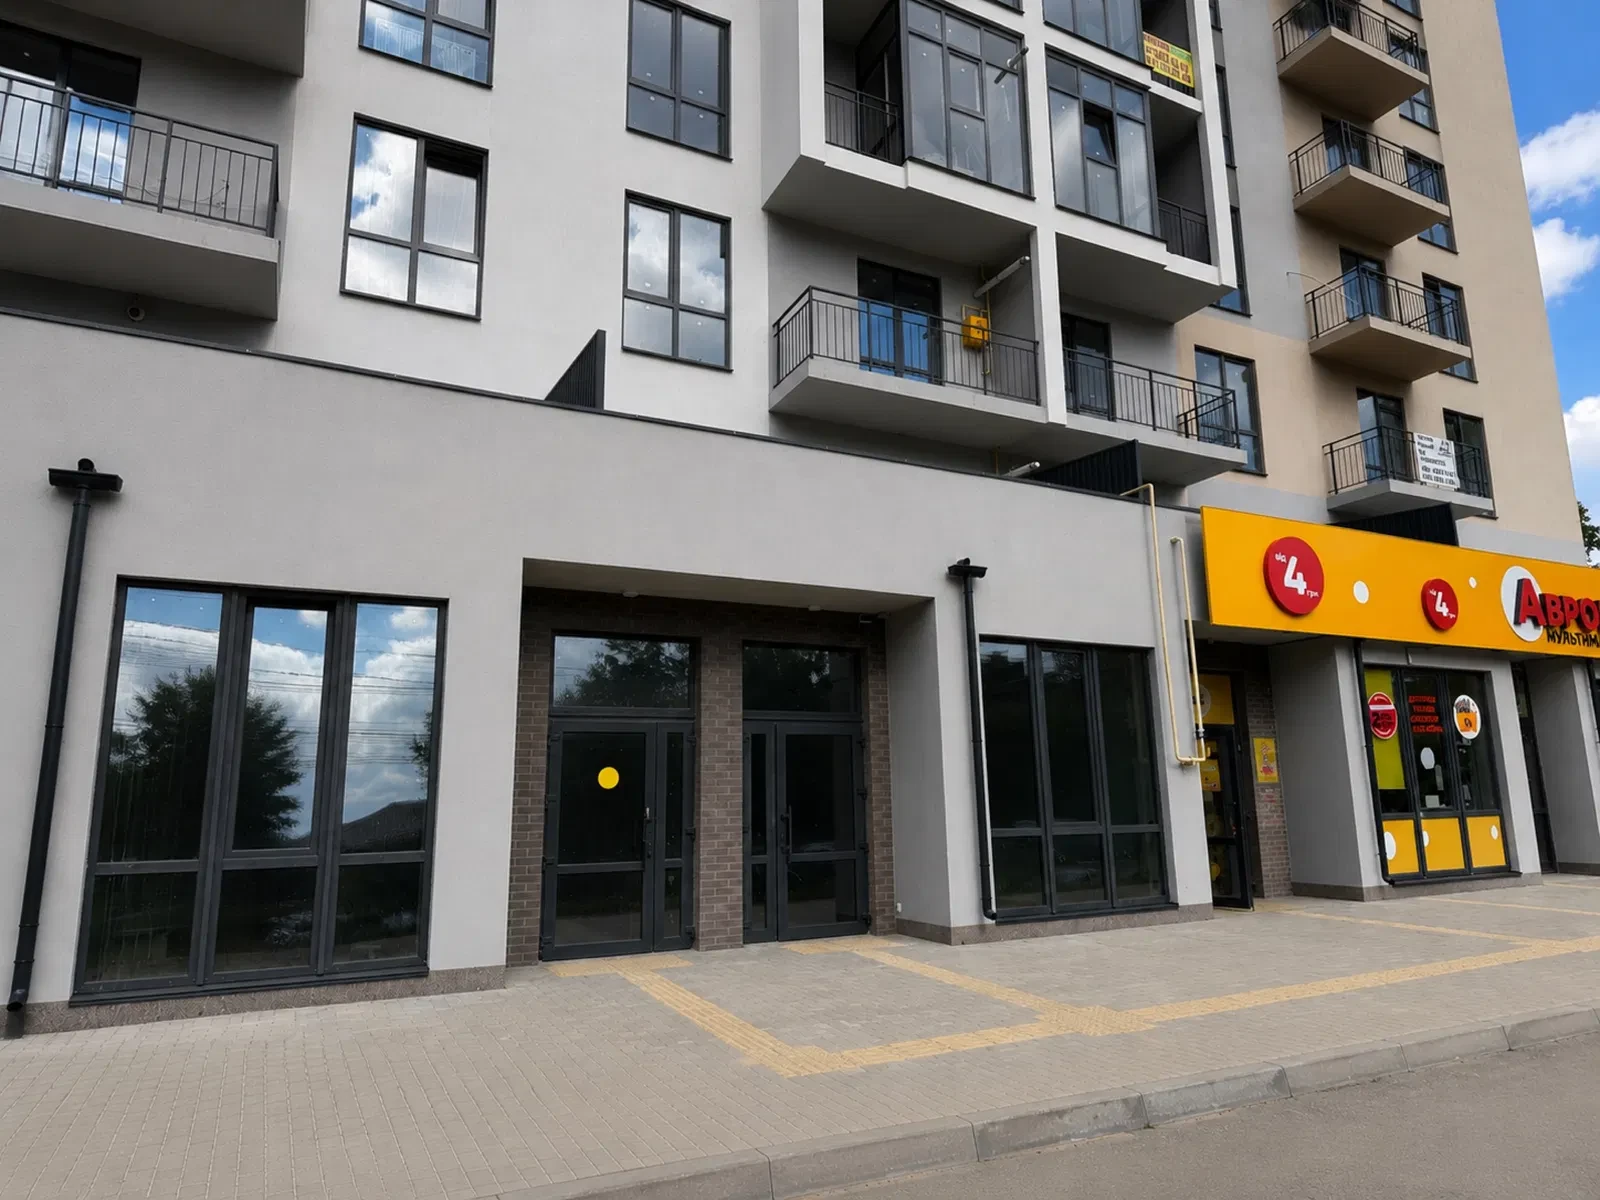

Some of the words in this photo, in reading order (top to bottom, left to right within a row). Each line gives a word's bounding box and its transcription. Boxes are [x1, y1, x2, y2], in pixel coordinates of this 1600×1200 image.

[1284, 555, 1307, 595] 4
[1435, 591, 1449, 617] 4
[1514, 577, 1600, 633] АВРО
[1546, 628, 1600, 649] МУЛЬТИМ
